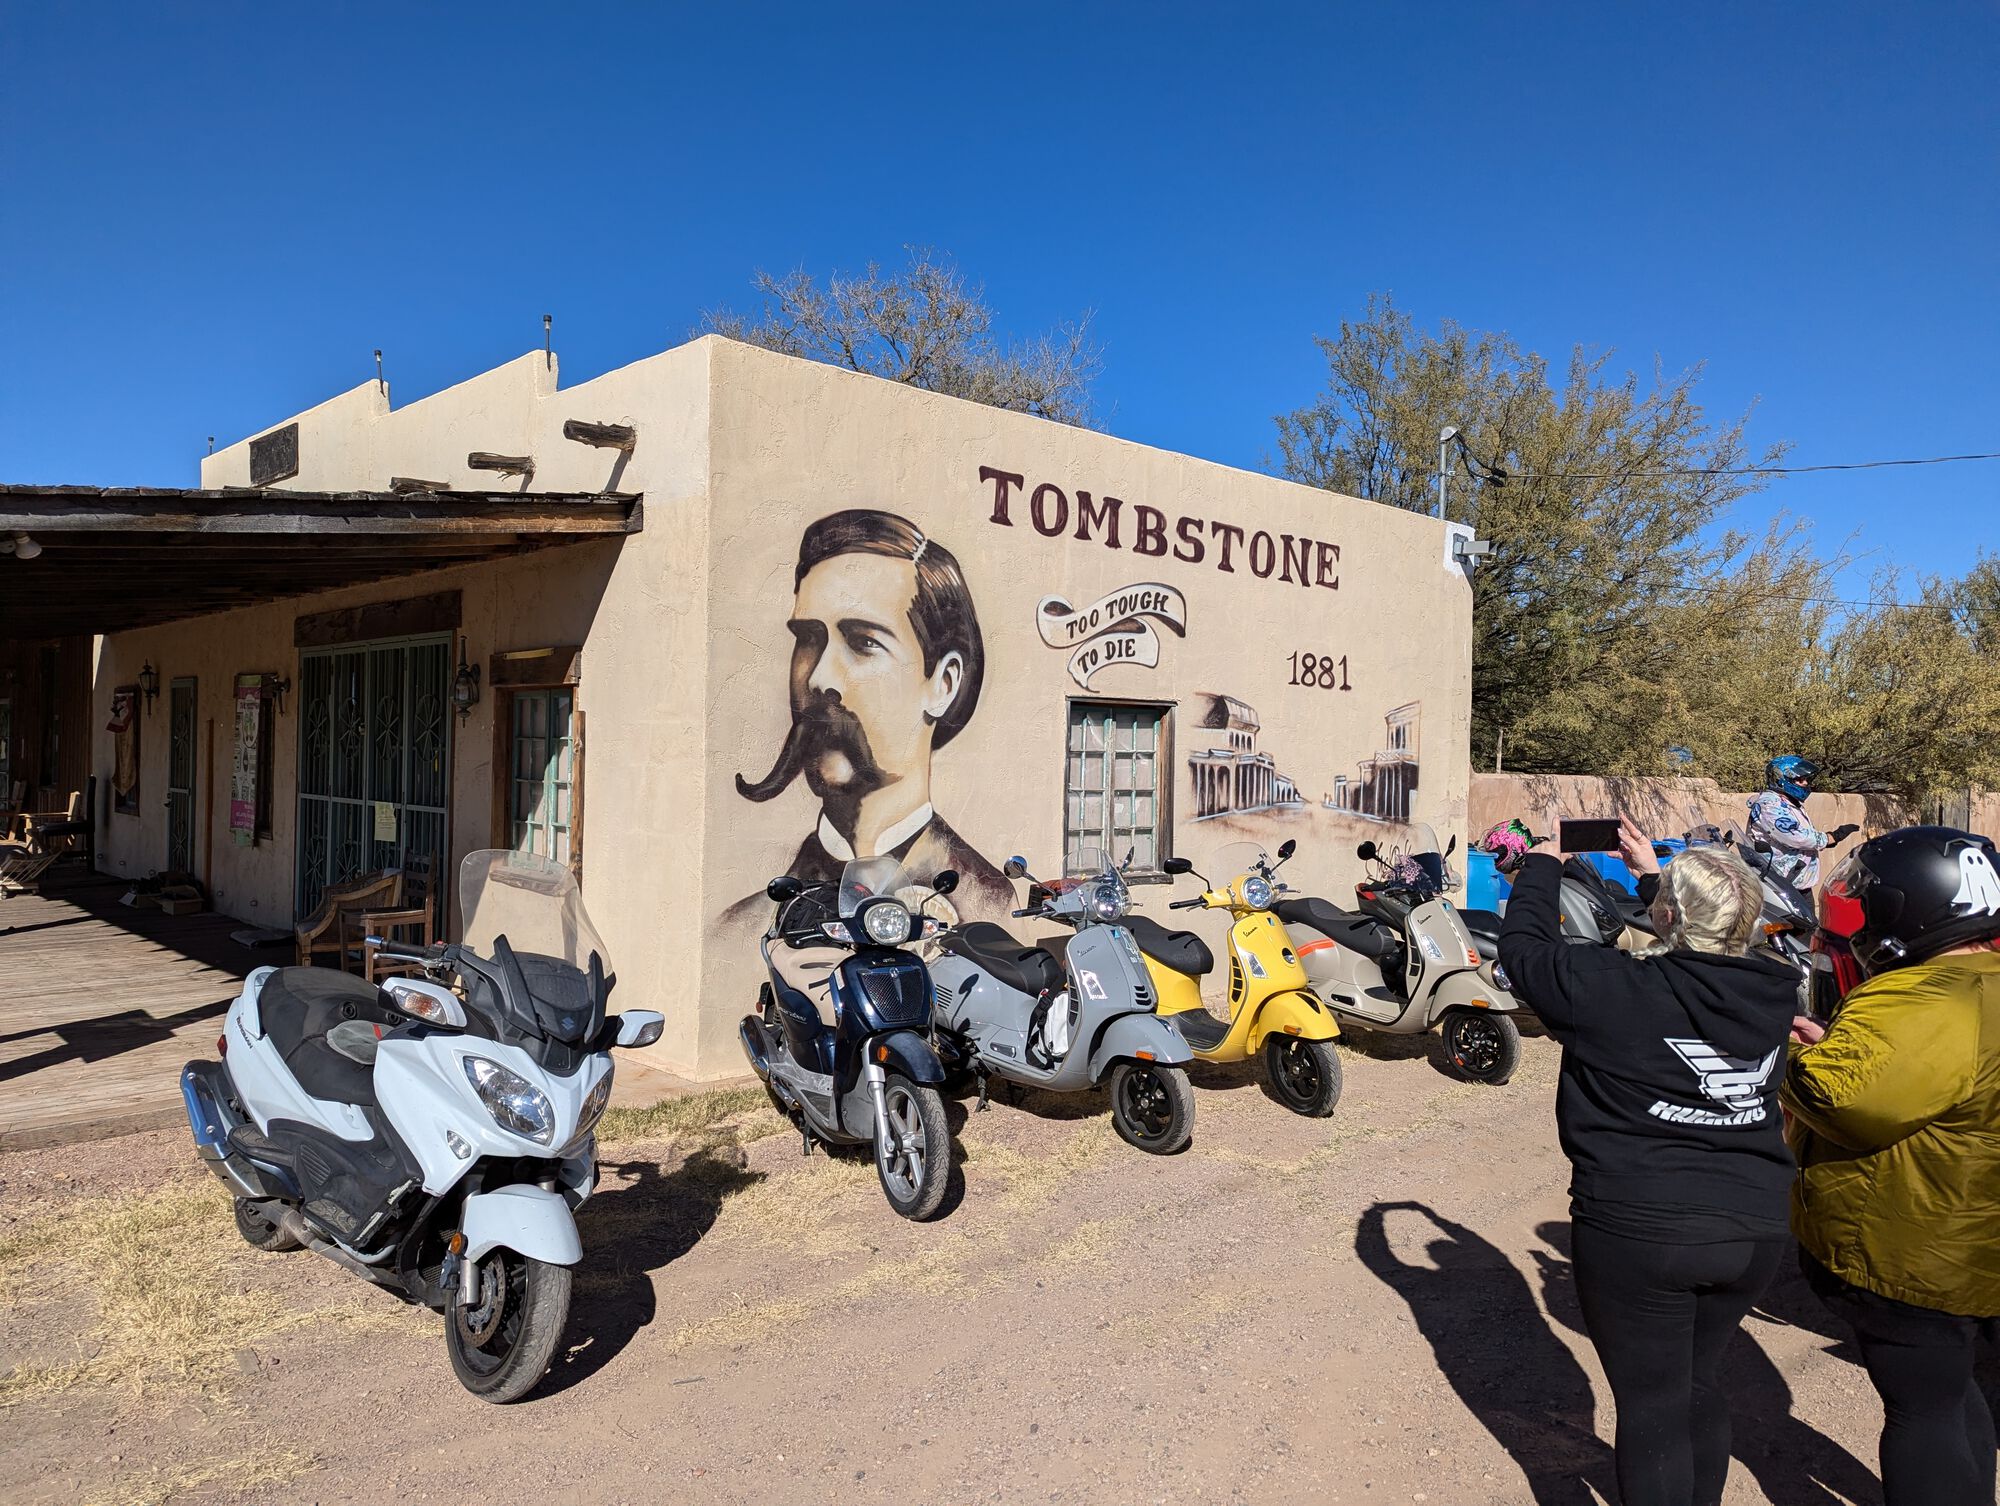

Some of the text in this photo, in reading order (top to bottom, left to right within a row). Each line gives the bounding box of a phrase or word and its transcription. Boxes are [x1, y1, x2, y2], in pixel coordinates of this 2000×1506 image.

[978, 465, 1341, 590] TOMBSTONE
[1066, 591, 1170, 640] TOO TOUGH
[1077, 638, 1136, 674] TO DIE
[1286, 650, 1353, 692] 1881
